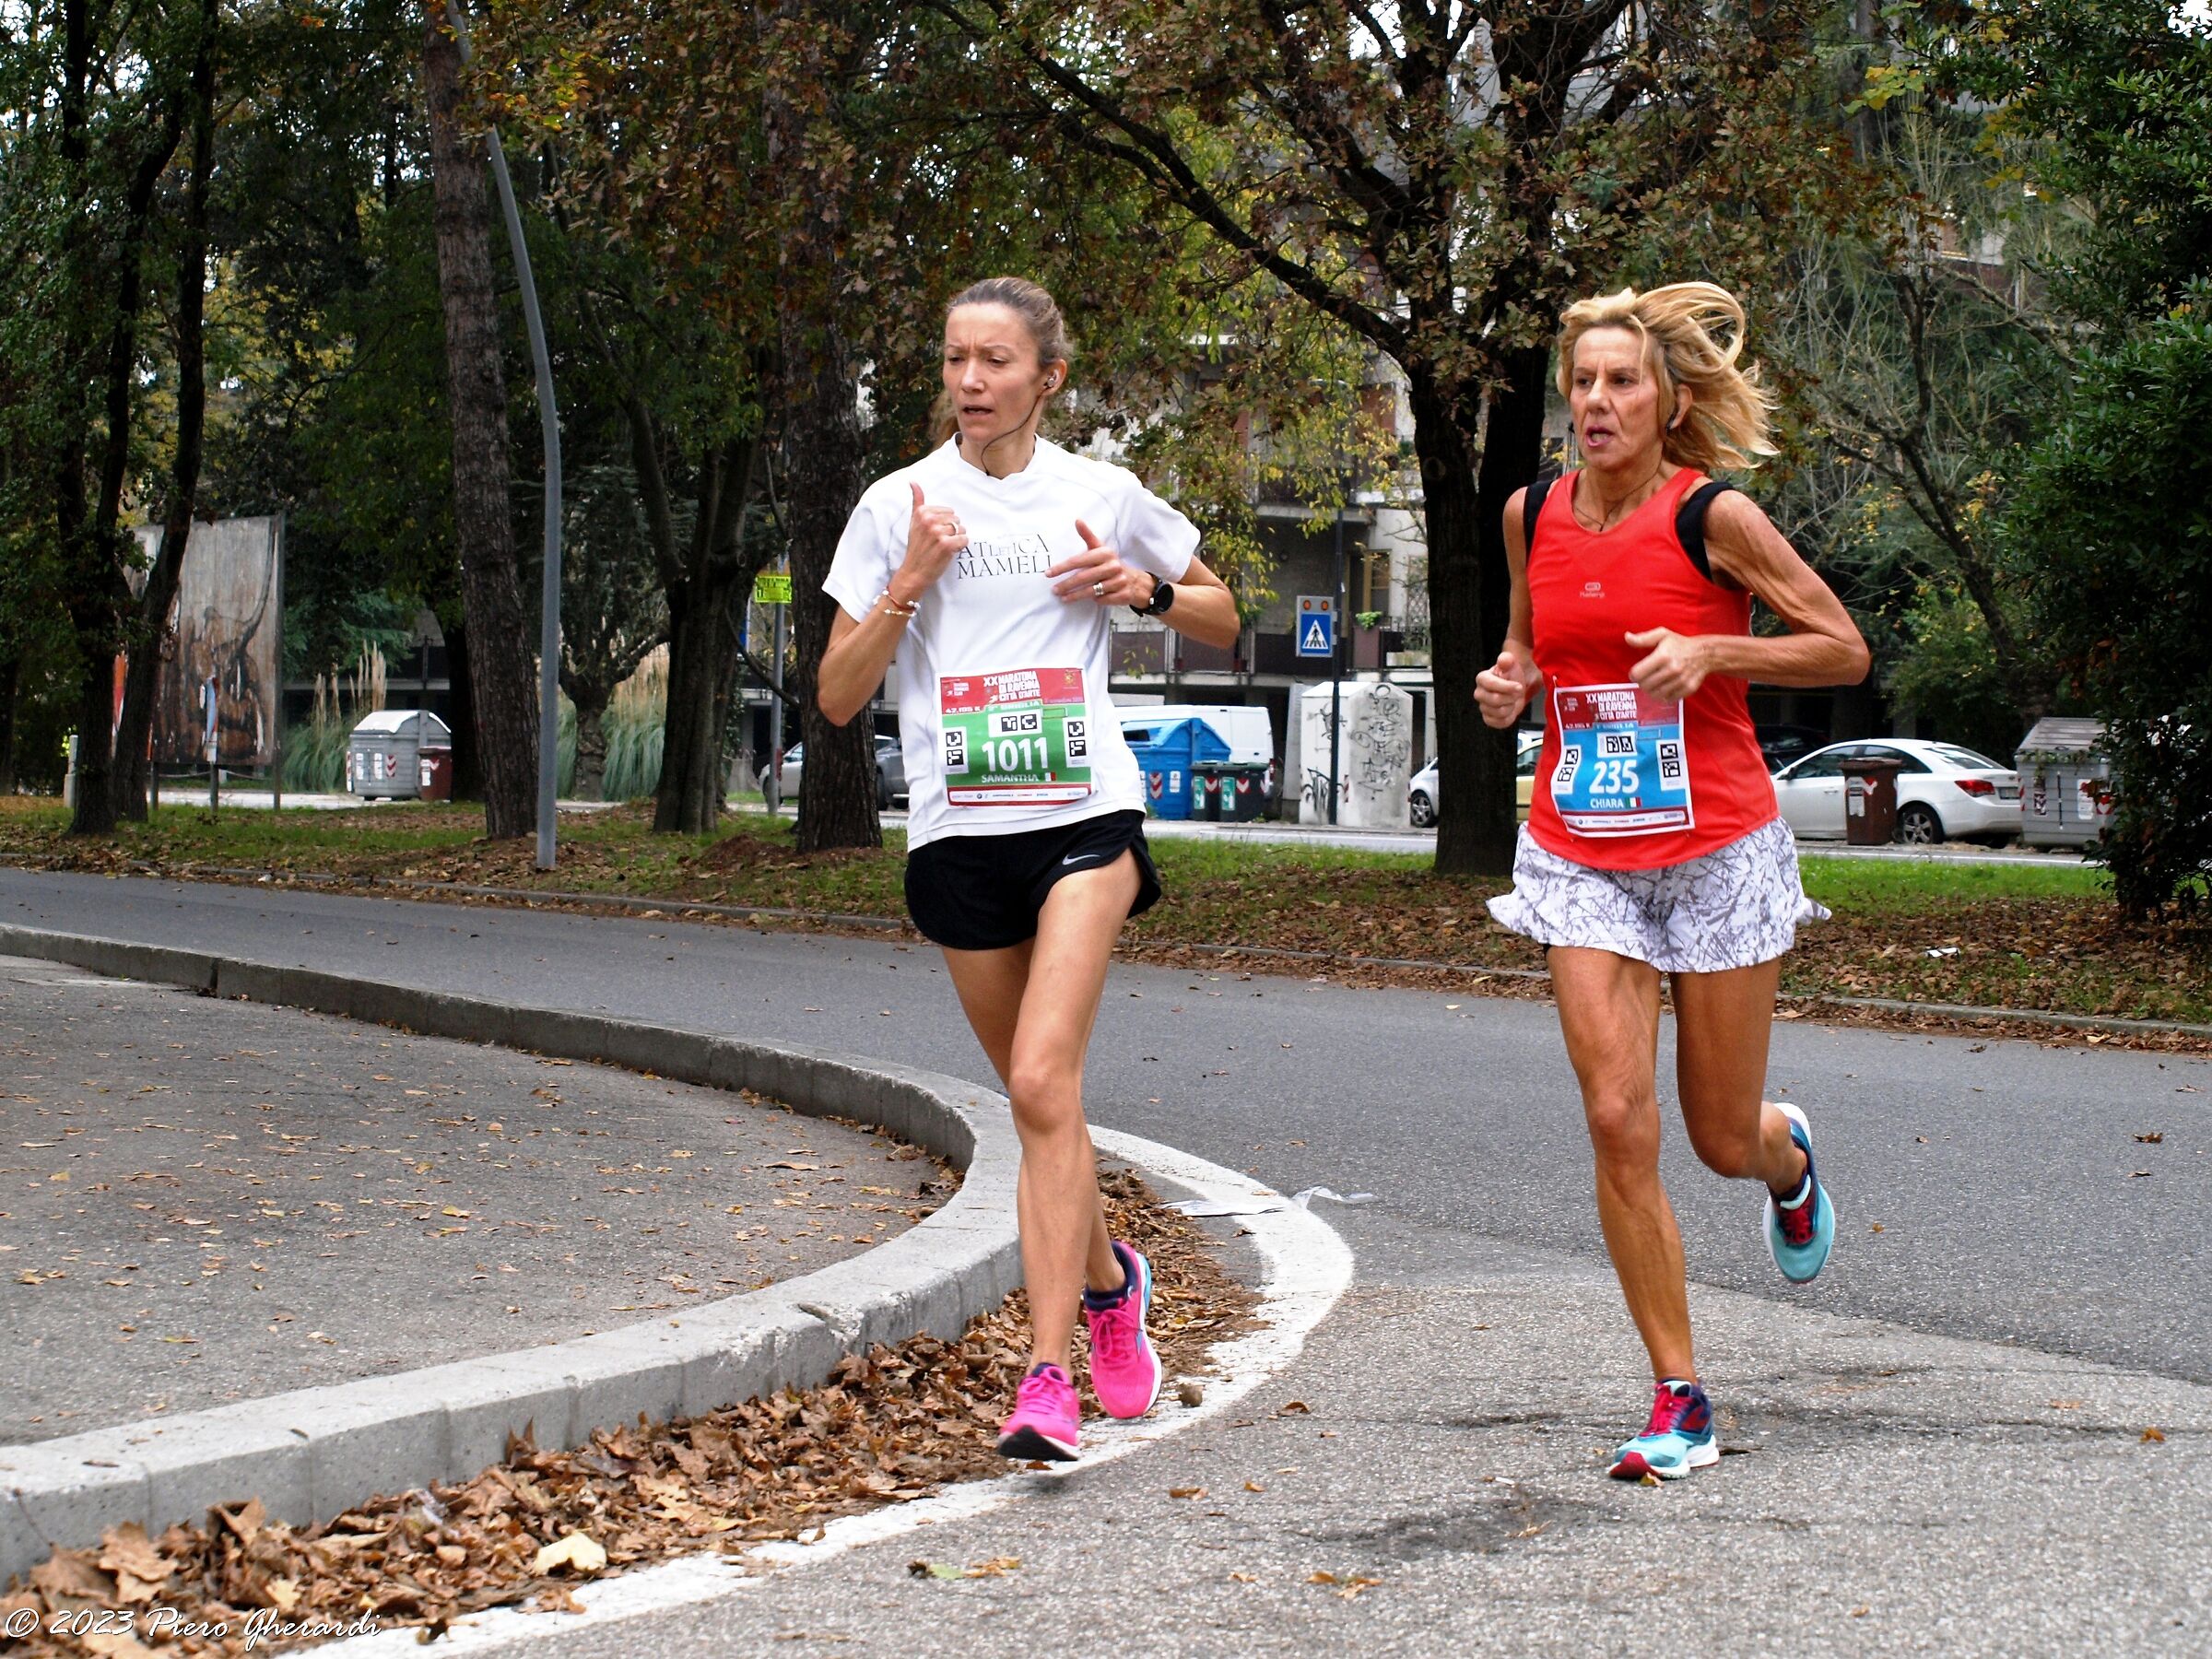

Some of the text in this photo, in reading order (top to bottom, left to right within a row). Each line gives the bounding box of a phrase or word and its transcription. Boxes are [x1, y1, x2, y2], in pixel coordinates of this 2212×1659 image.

[1597, 690, 1635, 701] MARATONA
[981, 736, 1049, 771] 1011
[981, 772, 1039, 783] SAMANTHA
[1589, 759, 1639, 794] 235
[1590, 797, 1624, 808] CHIARA
